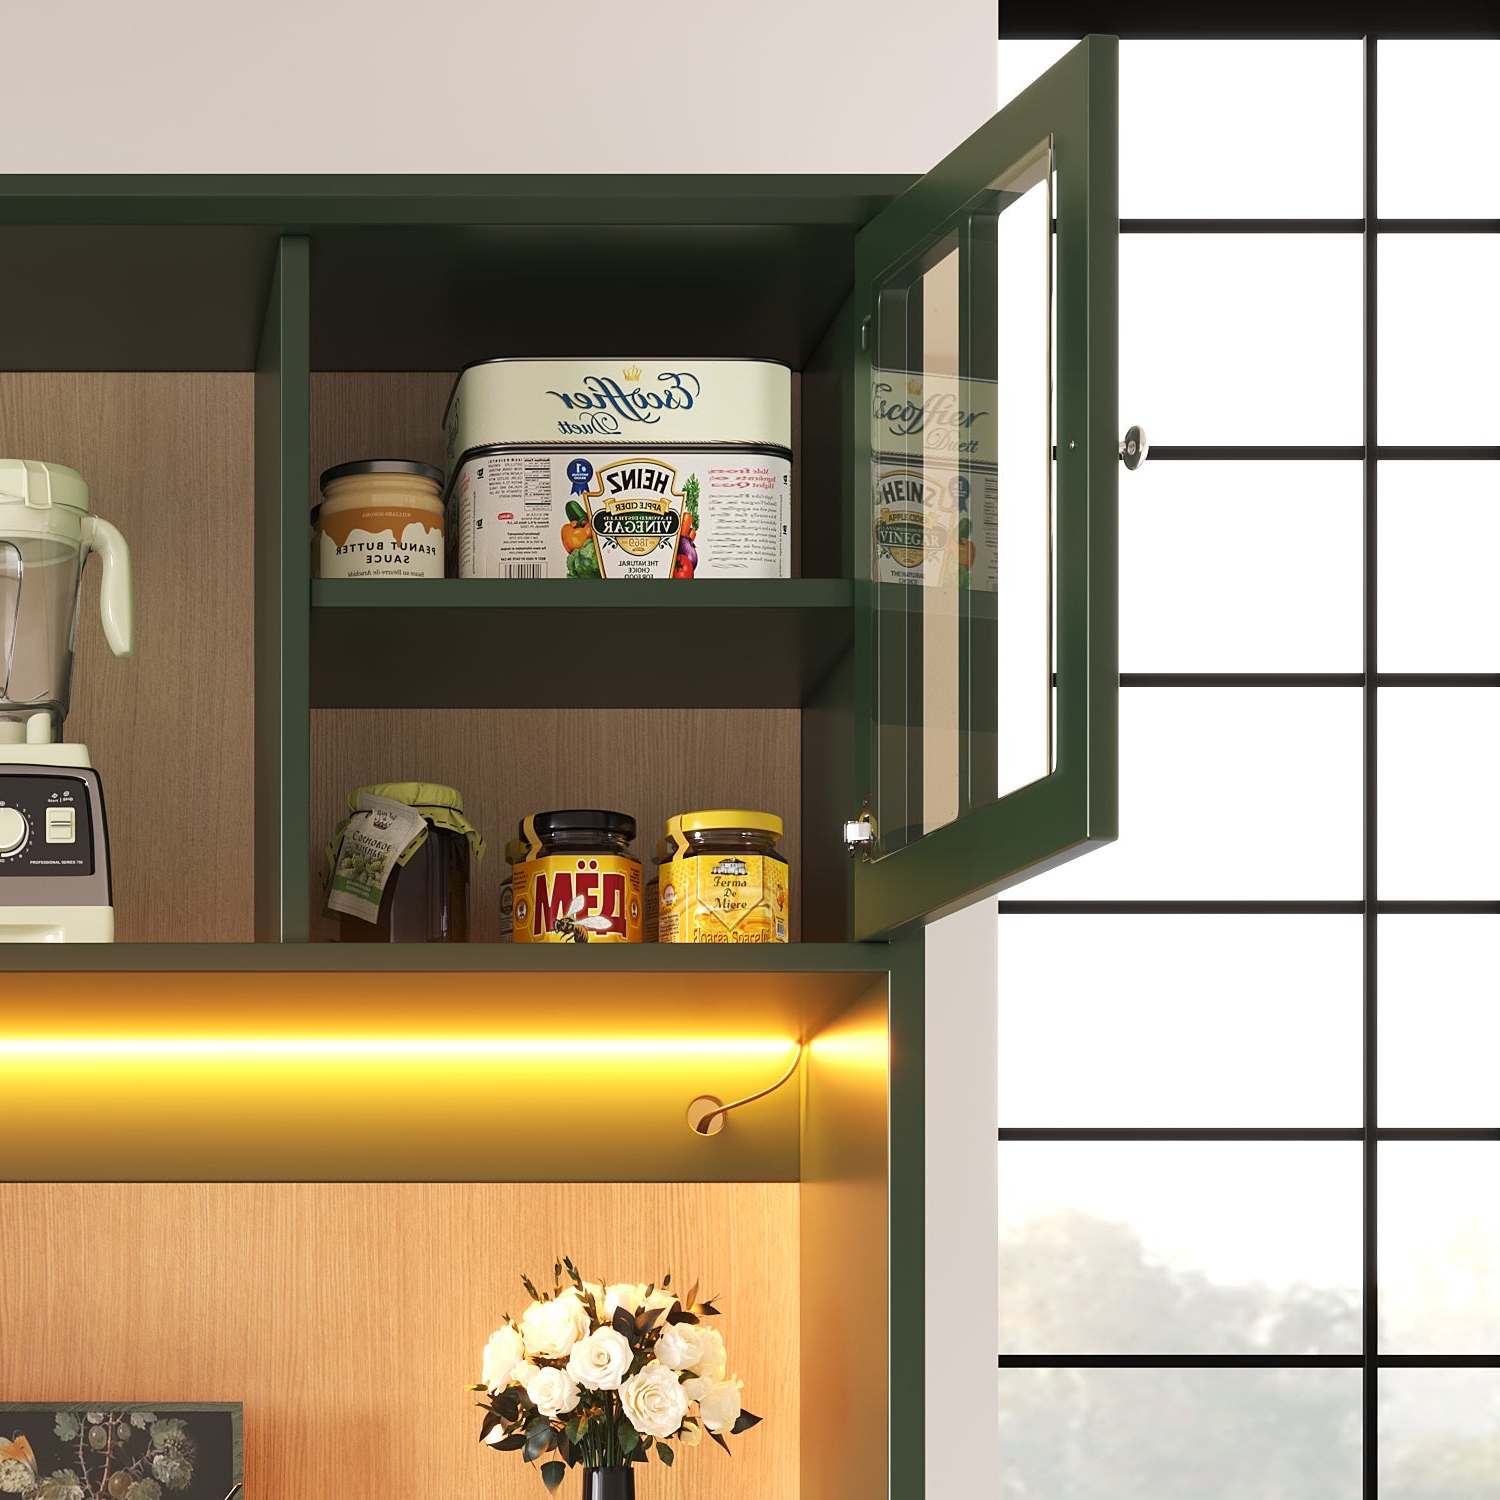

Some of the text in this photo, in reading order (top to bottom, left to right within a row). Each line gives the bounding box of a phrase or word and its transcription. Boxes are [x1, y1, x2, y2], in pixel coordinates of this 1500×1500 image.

[713, 876, 747, 887] Ferma
[724, 888, 737, 897] De
[534, 859, 627, 939] МЁД
[713, 898, 747, 909] Miere
